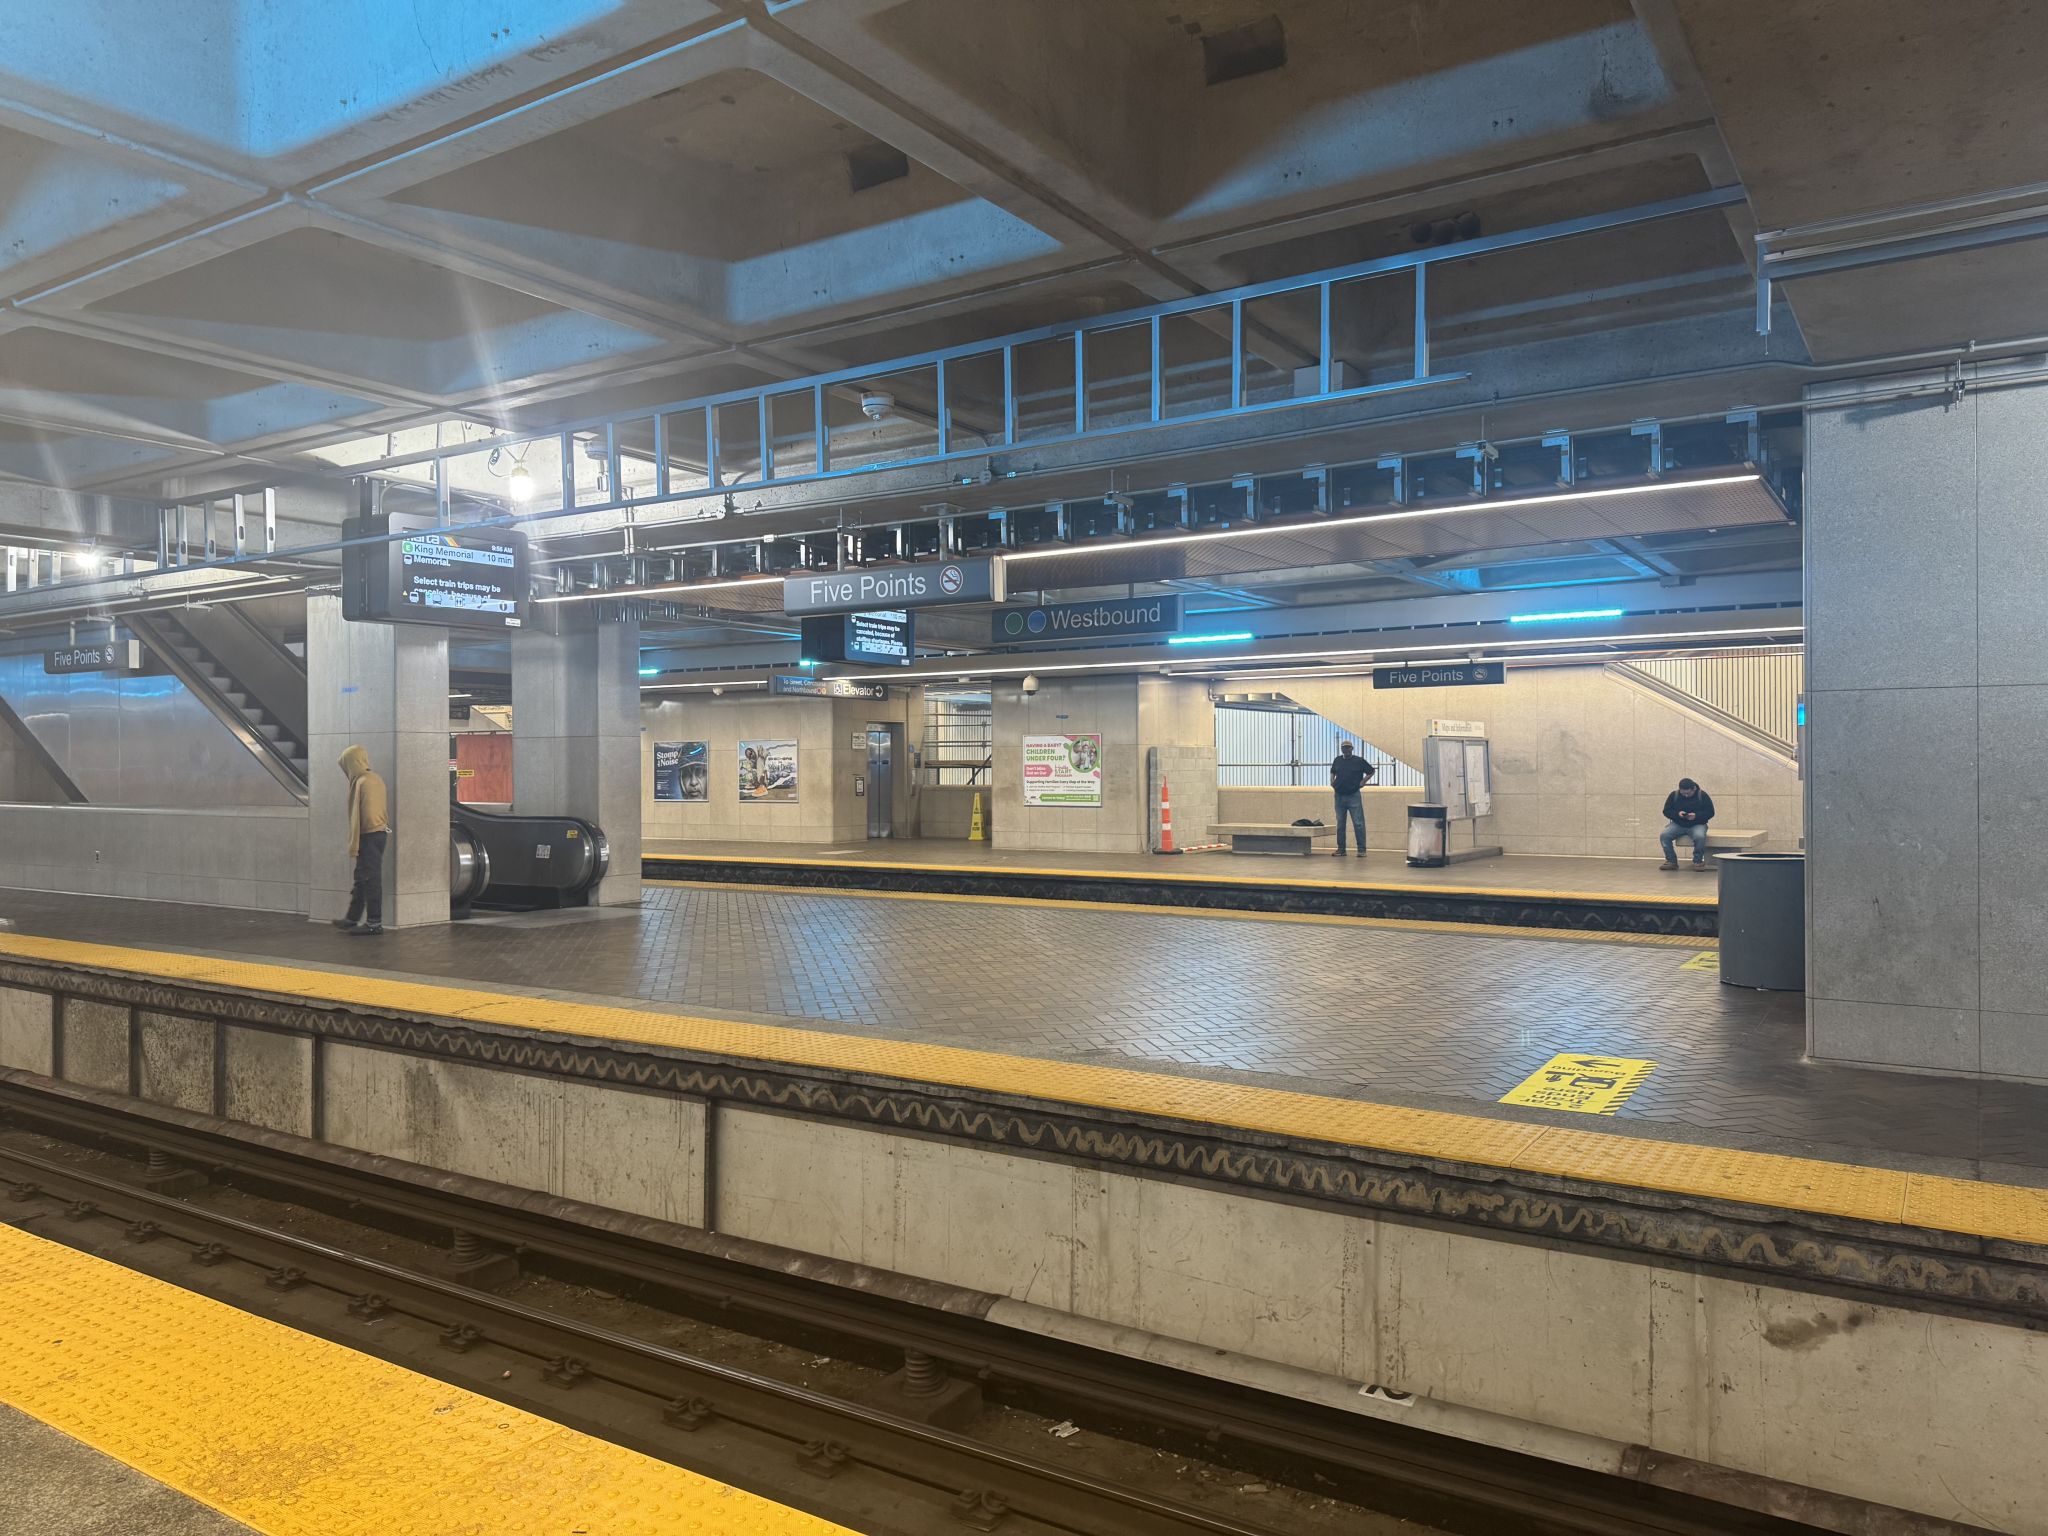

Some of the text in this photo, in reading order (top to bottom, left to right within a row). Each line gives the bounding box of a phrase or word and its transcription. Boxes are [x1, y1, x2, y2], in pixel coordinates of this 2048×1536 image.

[414, 544, 434, 556] King
[435, 547, 474, 560] Memorial
[487, 553, 496, 562] 10
[497, 557, 512, 565] min
[414, 556, 451, 567] Memorial.
[414, 576, 501, 593] Select train trips may be
[810, 571, 927, 604] Five Points
[1050, 602, 1161, 630] Westbound
[54, 649, 100, 666] Five Points
[1389, 668, 1464, 684] Five Points
[843, 684, 874, 696] Elevator
[656, 751, 679, 760] Stomp
[660, 758, 679, 767] Noise
[1550, 1065, 1626, 1076] Boarding
[1535, 1090, 1591, 1100] Ends
[1543, 1087, 1596, 1096] Here
[1519, 1099, 1562, 1107] Car
[1531, 1095, 1584, 1104] Train
